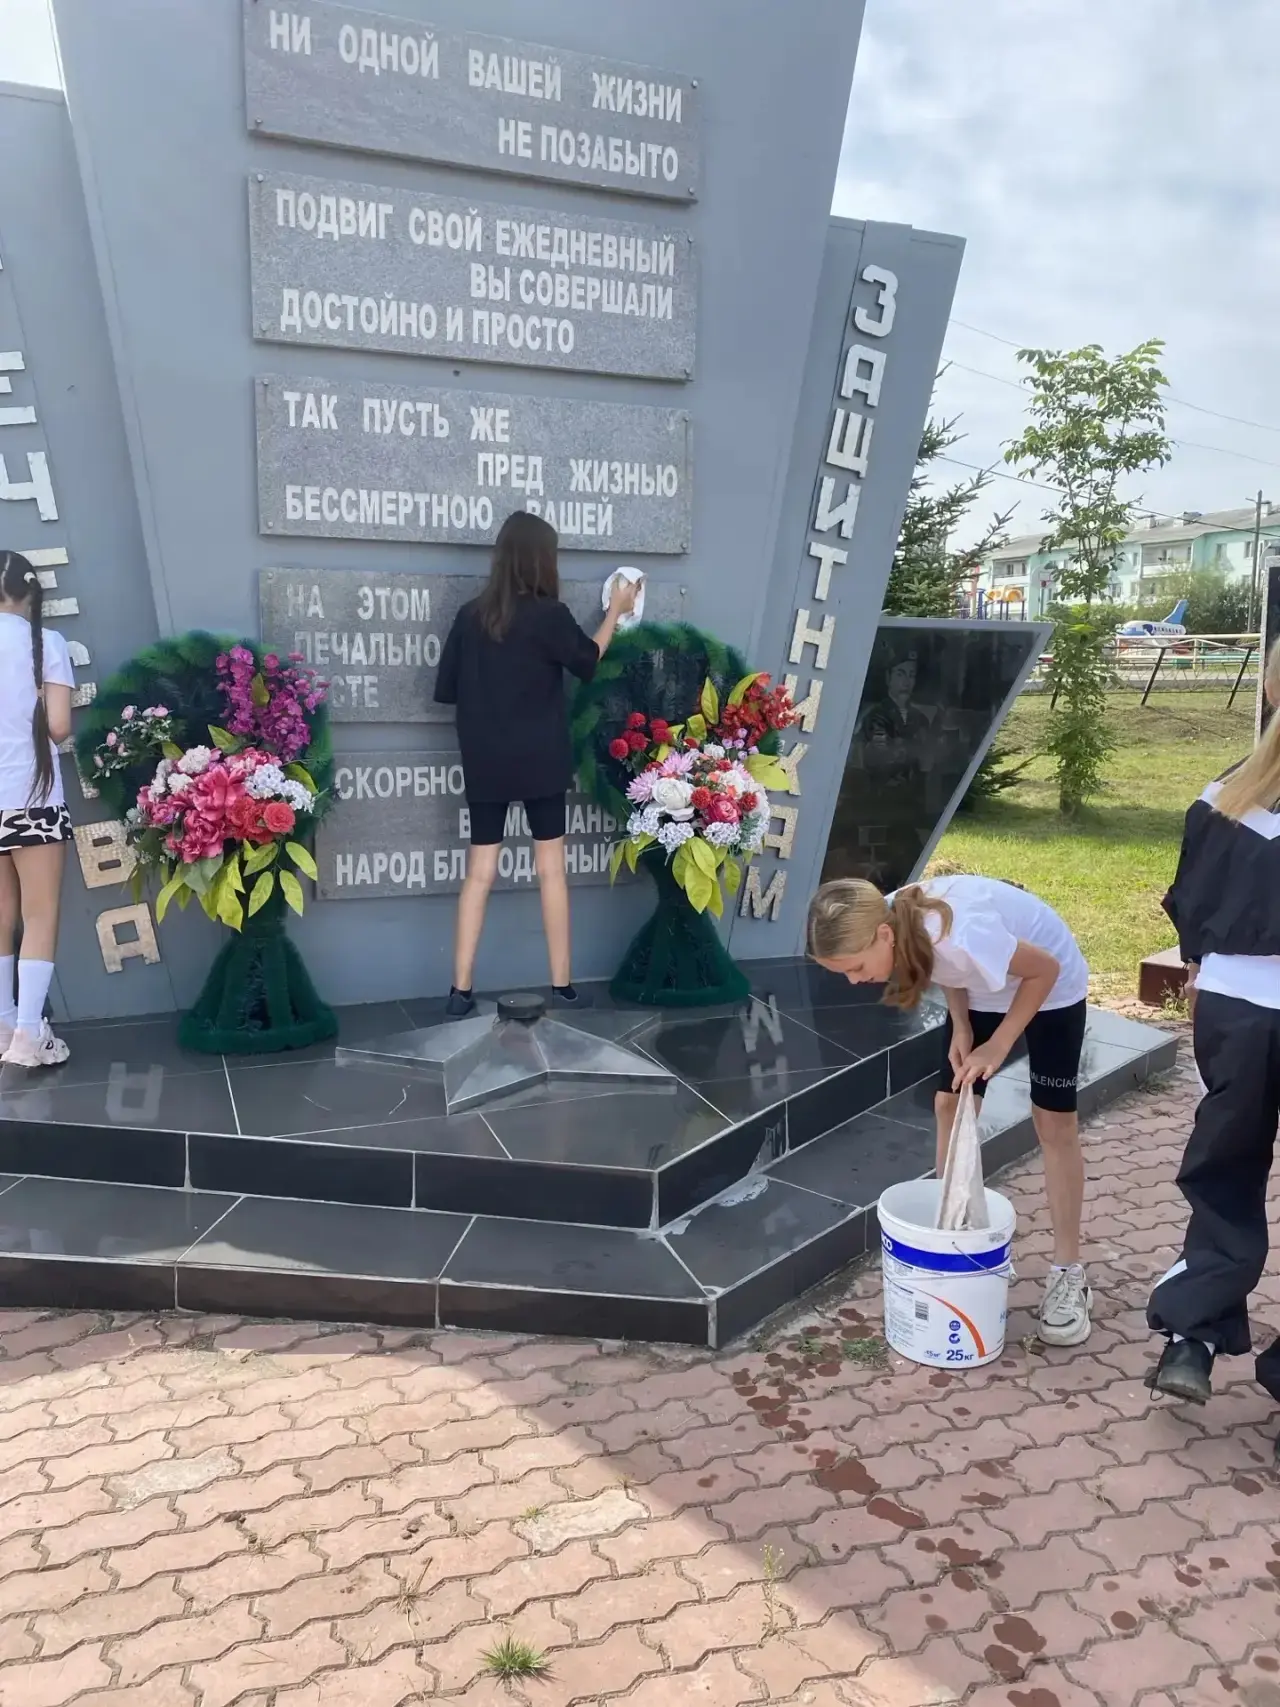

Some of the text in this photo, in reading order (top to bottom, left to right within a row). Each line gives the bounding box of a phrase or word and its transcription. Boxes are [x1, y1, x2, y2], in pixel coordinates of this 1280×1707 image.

[270, 10, 683, 123] НИ ОДНОЙ ВАШЕЙ ЖИЗНИ
[498, 118, 679, 182] НЕ ПОЗАБЫТО
[276, 189, 676, 277] ПОДВИГ СВОЙ ЕЖЕДНЕВНЫЙ
[470, 262, 674, 321] ВЫ СОВЕРШАЛИ
[280, 288, 575, 354] ДОСТОЙНО И ПРОСТО
[283, 391, 511, 443] ТАК ПУСТЬ ЖЕ
[477, 452, 679, 498] ПРЕД ЖИЗНЬЮ
[285, 485, 493, 531] БЕССМЕРТНОЮ
[286, 583, 431, 622] НА ЭТОМ
[336, 836, 615, 889] НАРОД БЛОДНЫЙ
